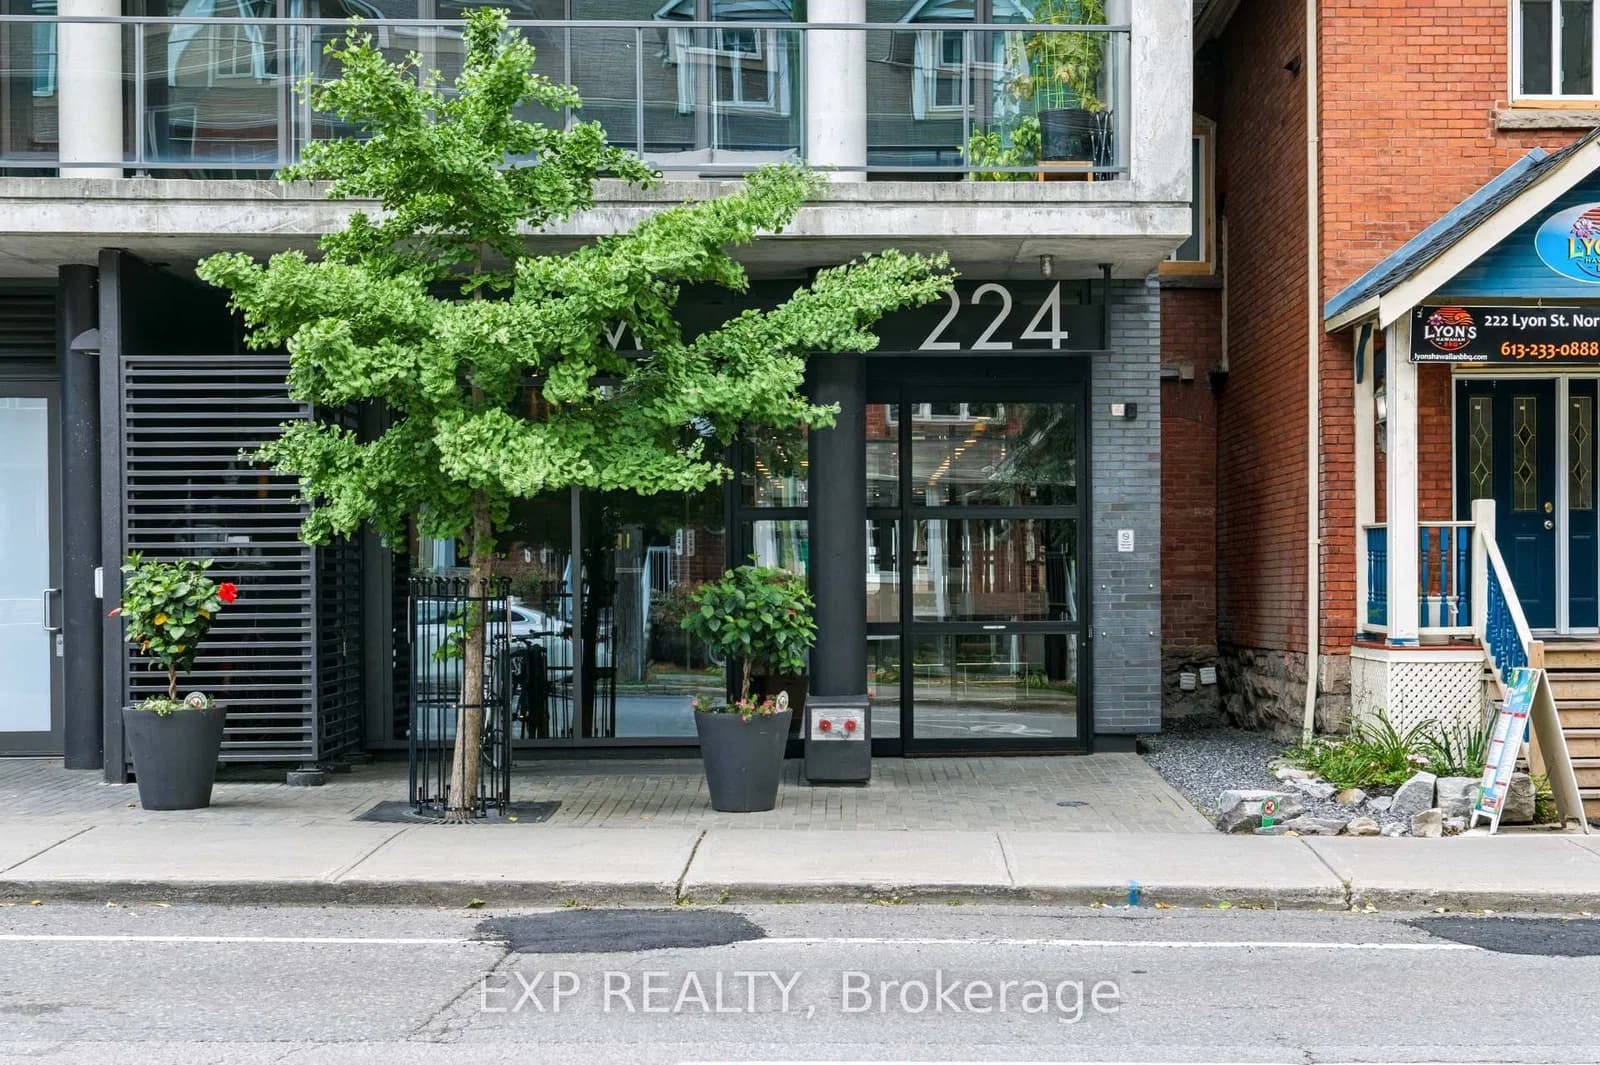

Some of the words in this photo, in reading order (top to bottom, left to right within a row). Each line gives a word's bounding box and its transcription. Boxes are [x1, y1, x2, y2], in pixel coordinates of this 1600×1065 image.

[918, 281, 1069, 350] 224
[1484, 315, 1509, 327] 222
[1512, 313, 1547, 331] Lyon
[1550, 314, 1570, 327] St.
[1424, 325, 1477, 340] LYON'S
[1501, 341, 1599, 359] 613-233-0888
